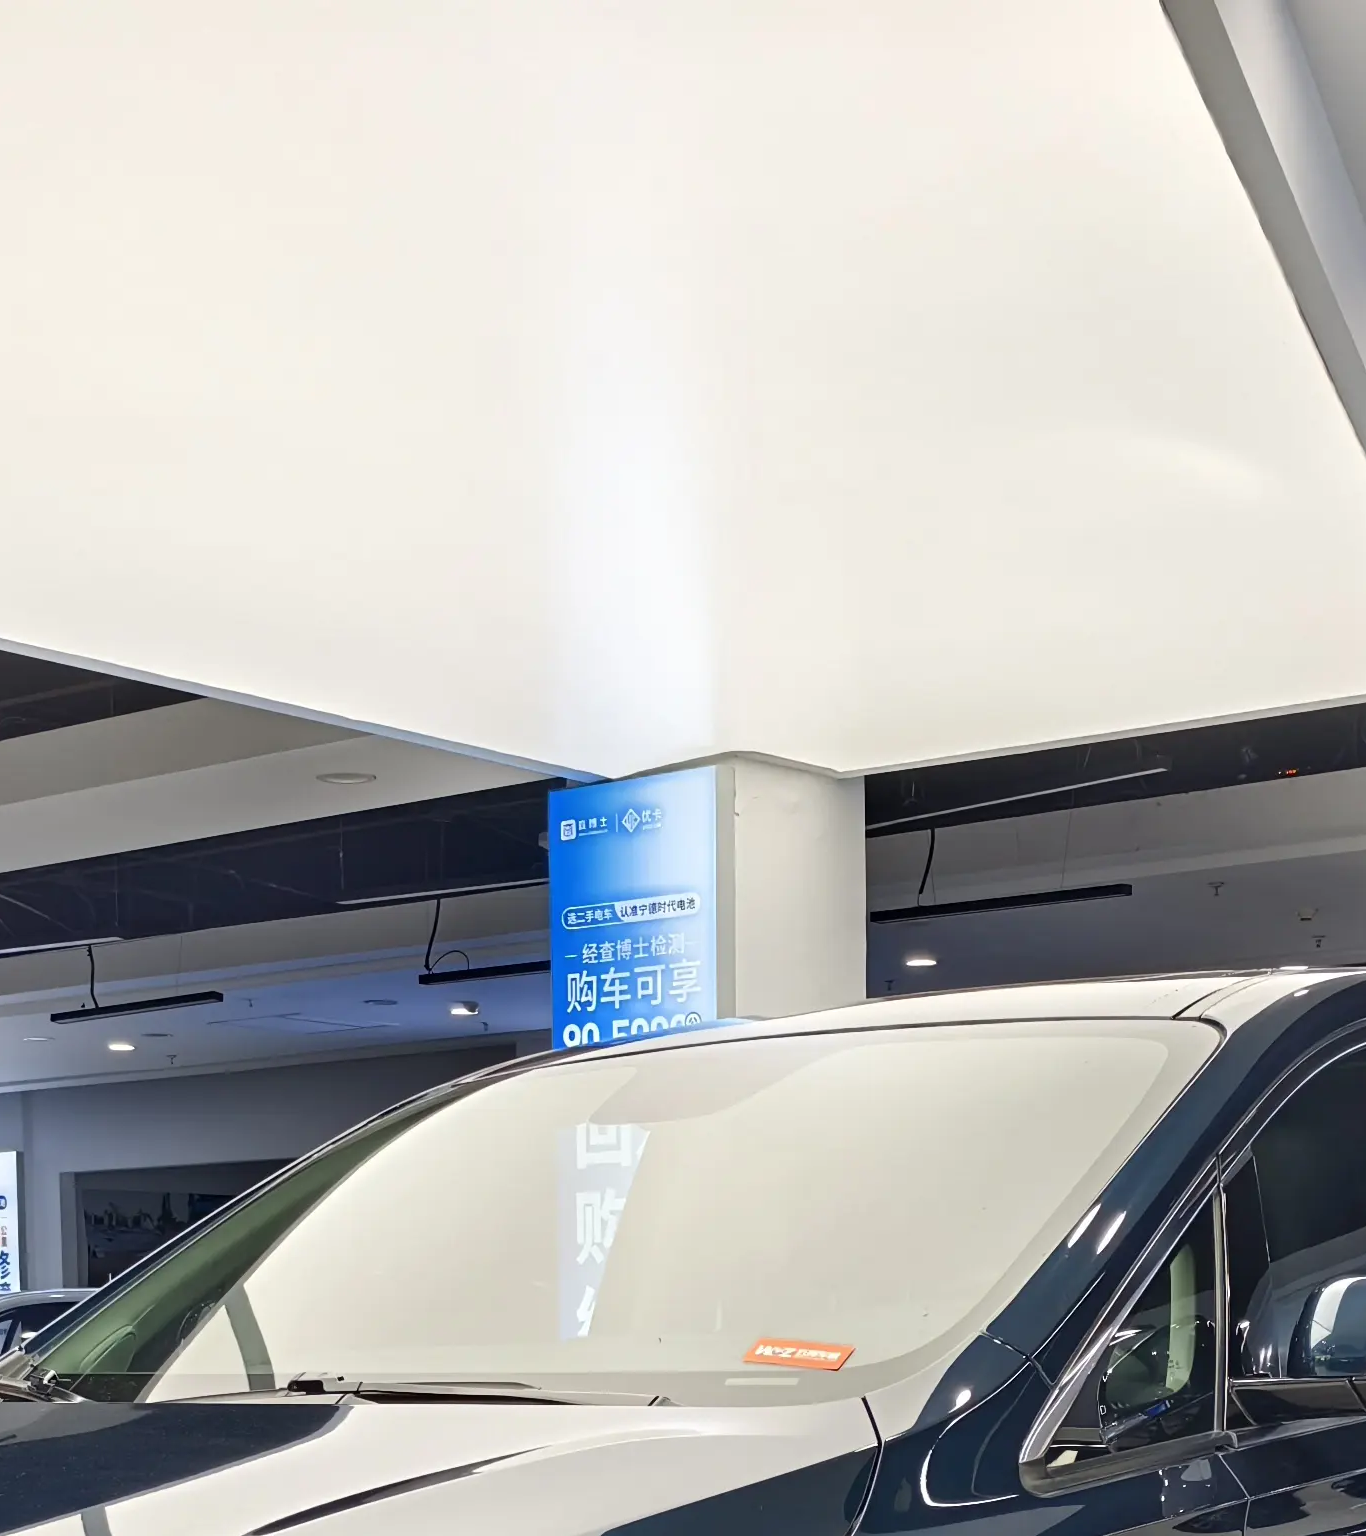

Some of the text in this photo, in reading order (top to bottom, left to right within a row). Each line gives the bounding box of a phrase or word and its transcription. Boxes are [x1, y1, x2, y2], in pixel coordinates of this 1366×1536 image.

[582, 932, 685, 964] 经查博士检测
[566, 959, 702, 1013] 购车可享
